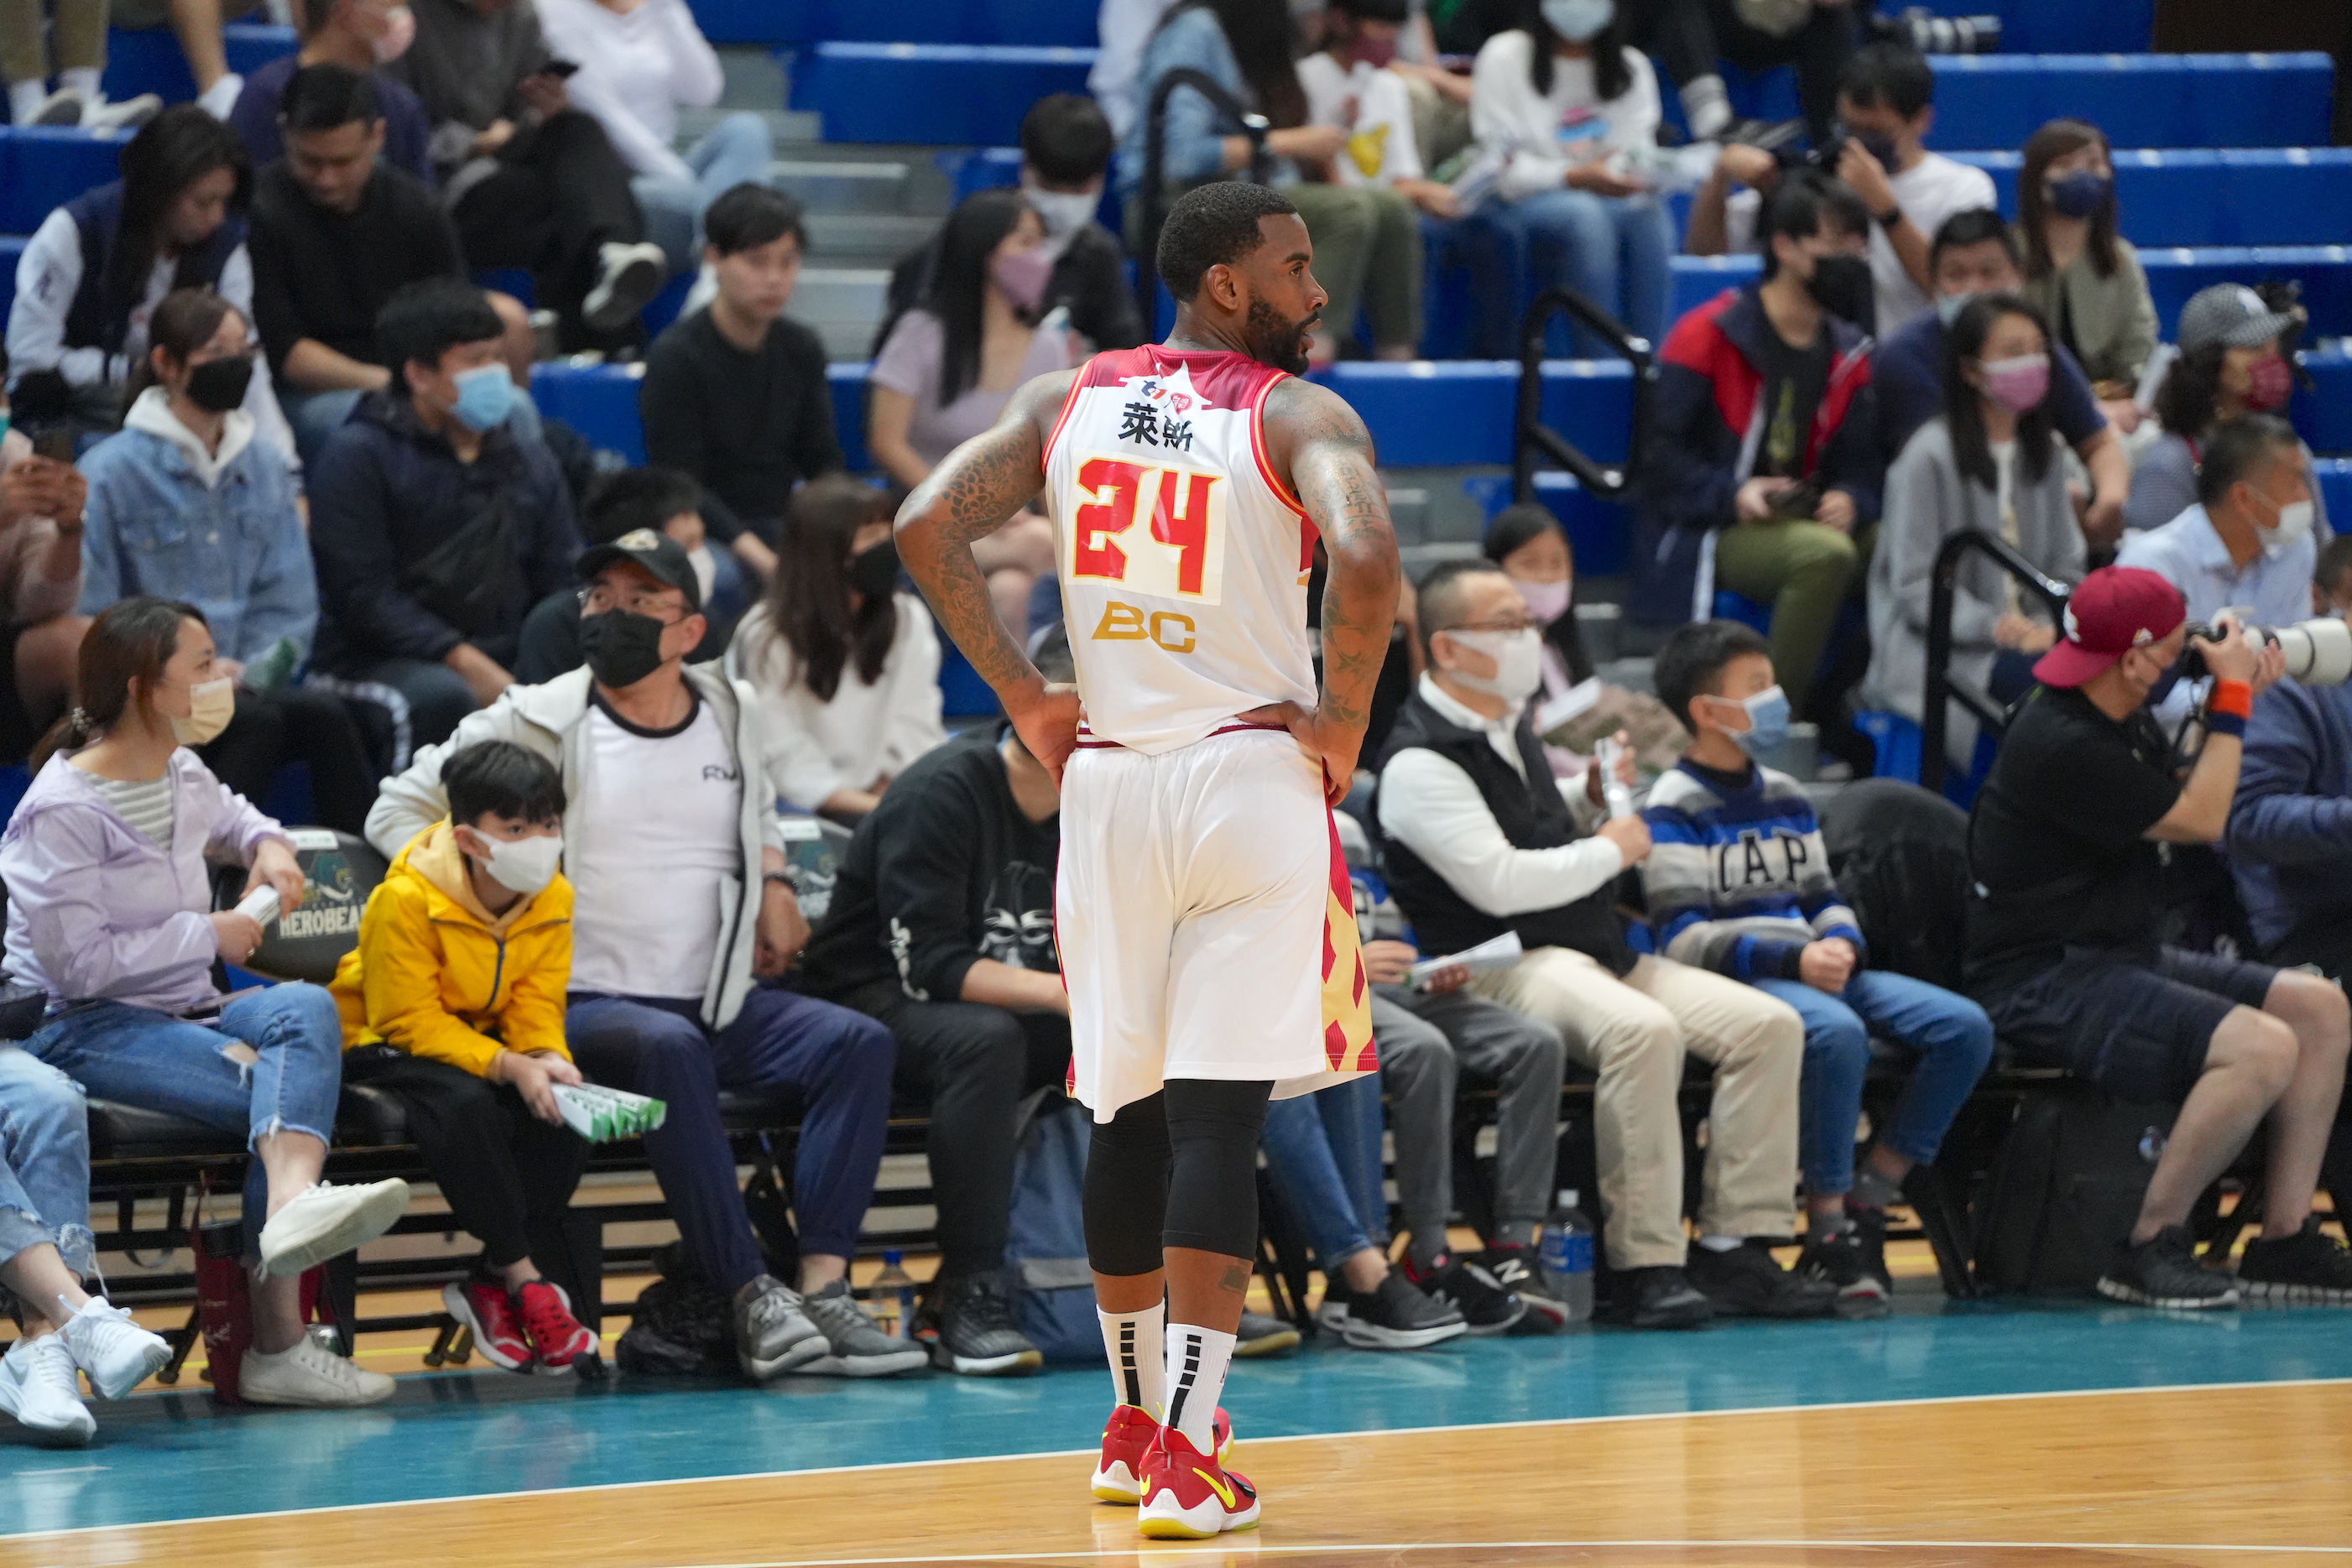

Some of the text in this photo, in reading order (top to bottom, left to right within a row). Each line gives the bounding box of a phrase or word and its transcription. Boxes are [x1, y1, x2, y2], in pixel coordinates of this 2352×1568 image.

[1118, 402, 1193, 452] 萊斯
[1073, 456, 1224, 596] 24
[1091, 601, 1196, 654] BC
